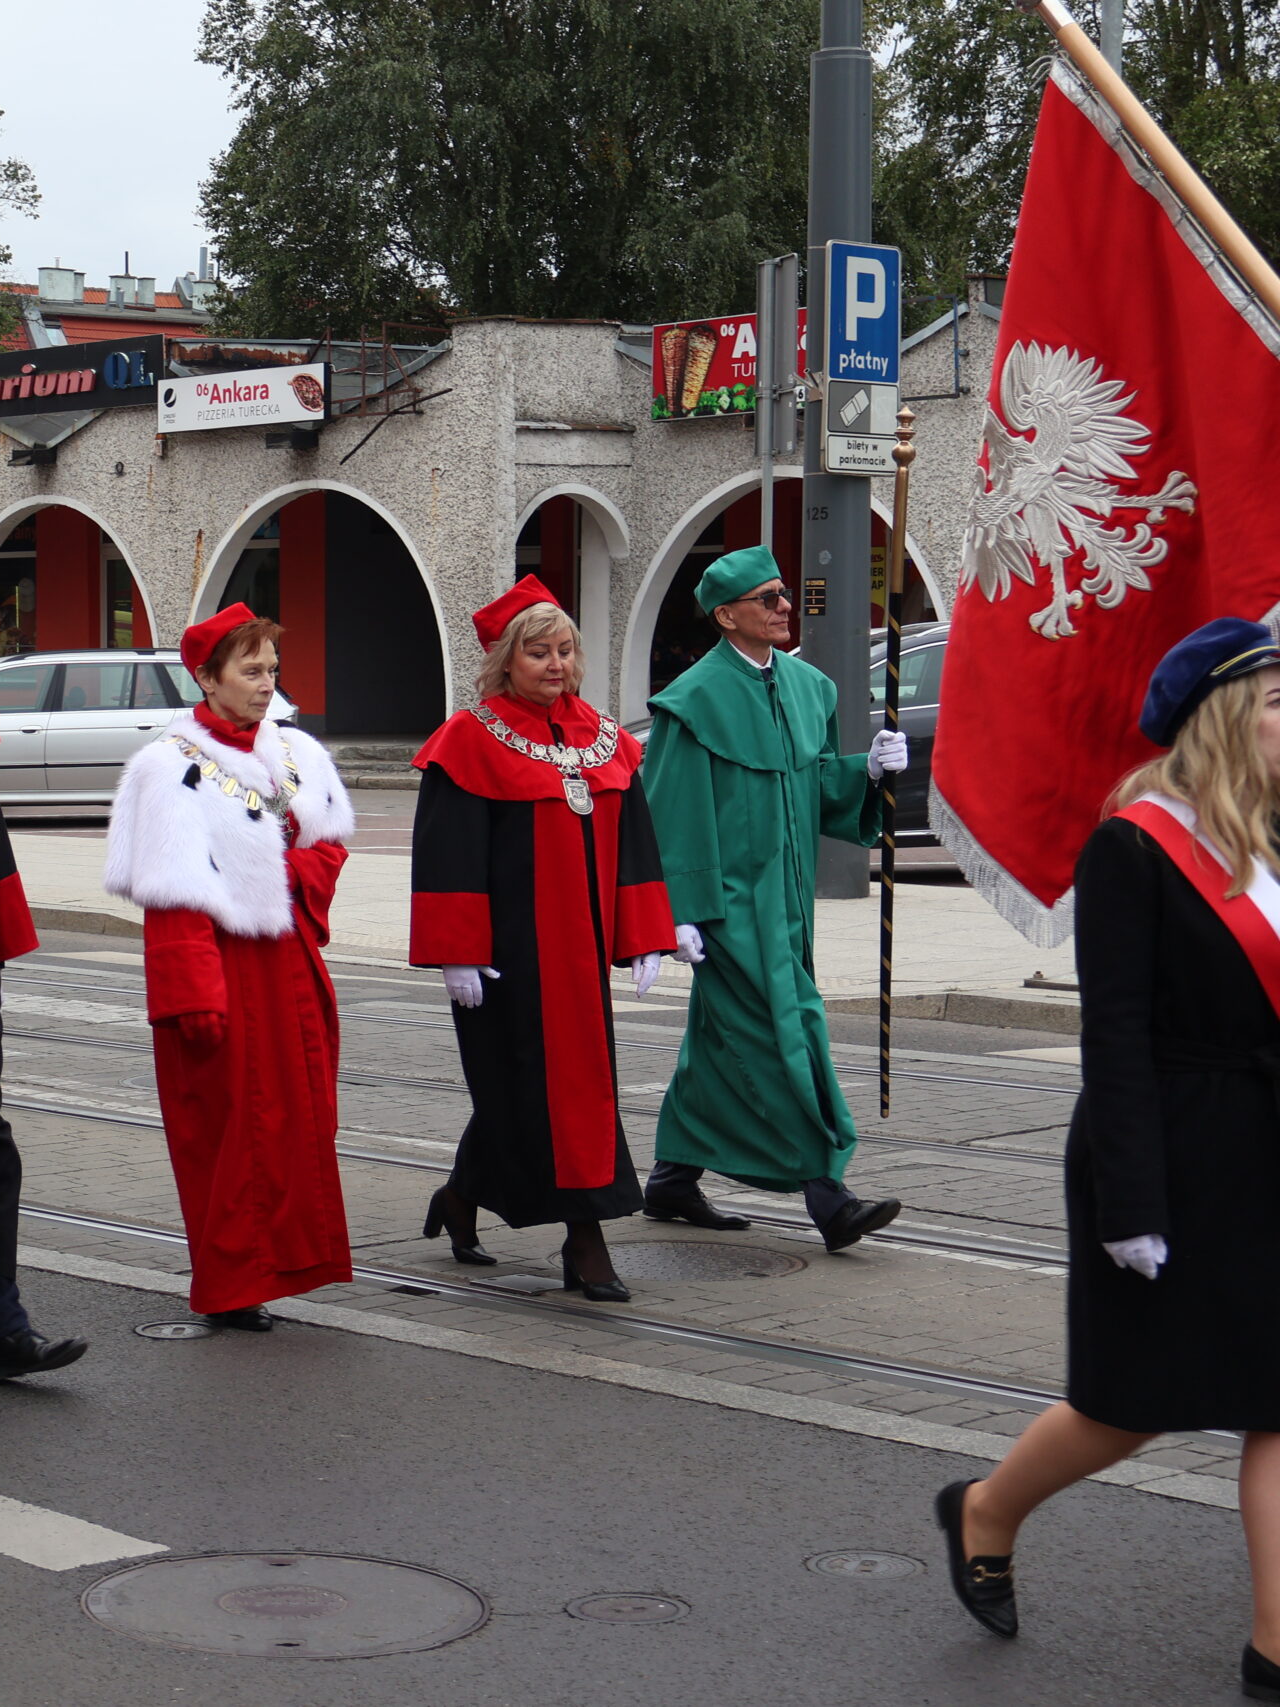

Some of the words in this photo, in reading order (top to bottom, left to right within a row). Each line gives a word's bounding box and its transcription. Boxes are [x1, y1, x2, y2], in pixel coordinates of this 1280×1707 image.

[845, 255, 886, 342] P
[720, 323, 735, 337] 06
[839, 348, 889, 376] płatny
[209, 380, 269, 405] Ankara
[197, 408, 236, 421] PIZZERIA
[239, 404, 281, 417] TURECKA
[846, 440, 870, 451] bilety
[839, 454, 886, 466] parkomacie
[870, 567, 884, 577] ER
